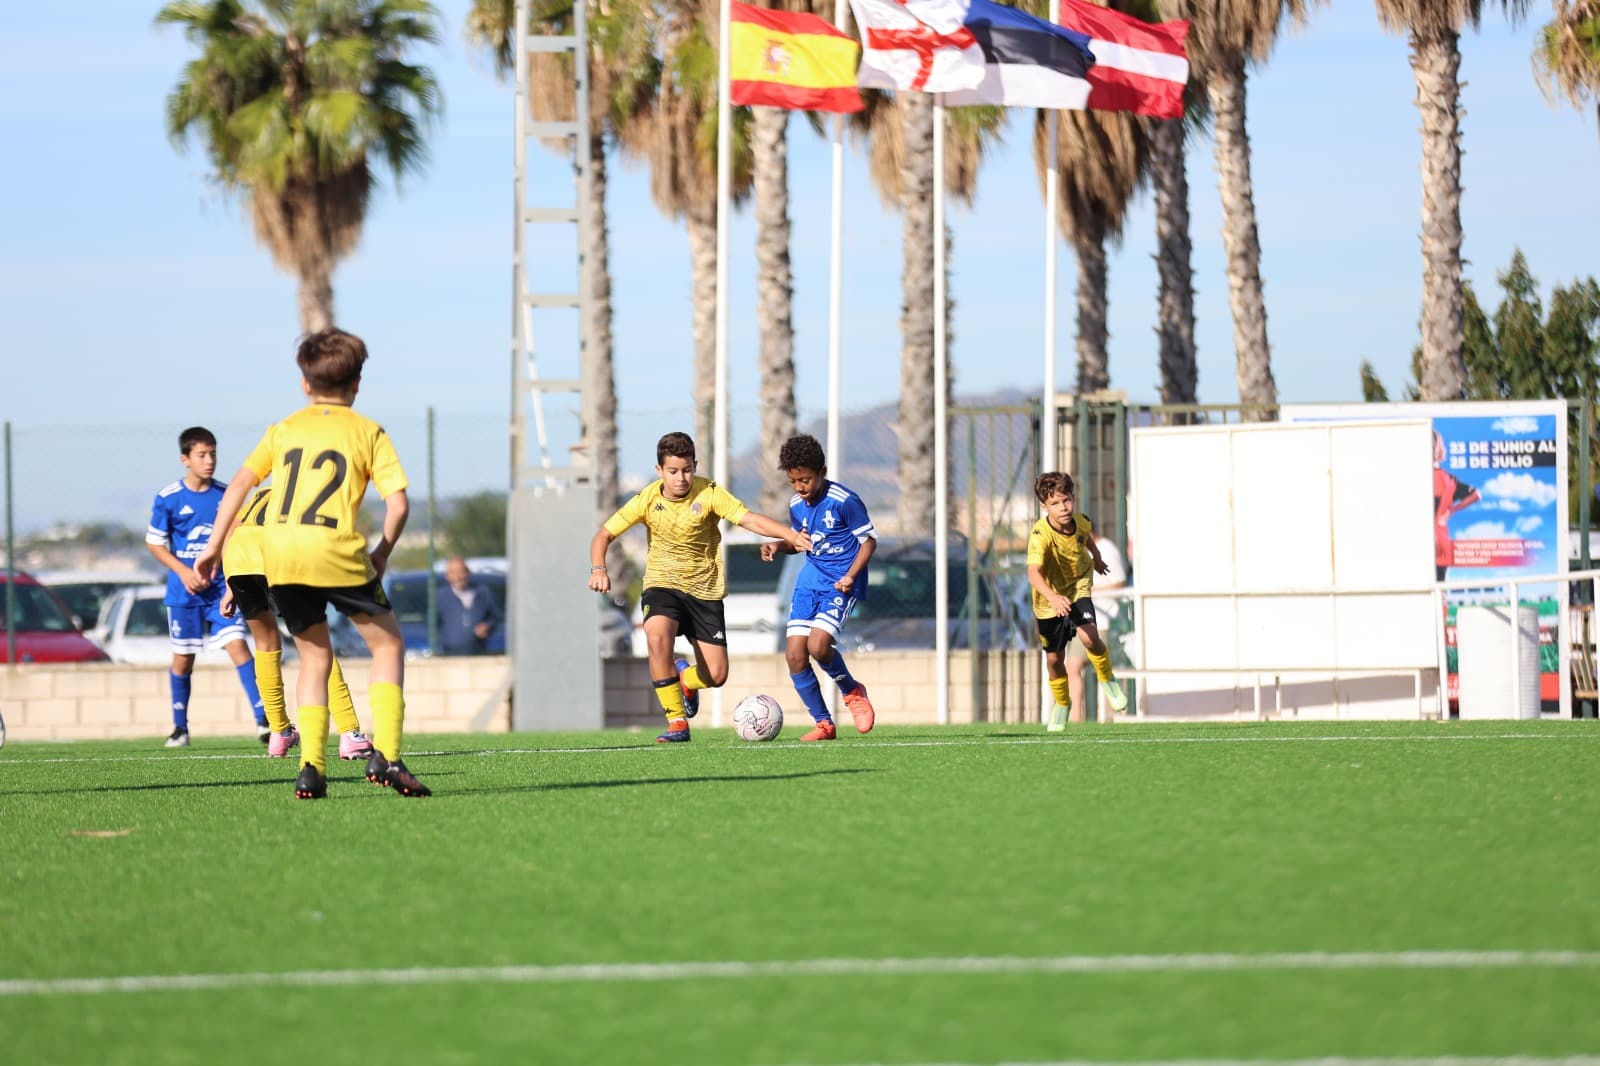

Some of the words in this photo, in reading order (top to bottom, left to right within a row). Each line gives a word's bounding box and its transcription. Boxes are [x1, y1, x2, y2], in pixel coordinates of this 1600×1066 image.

[1469, 440, 1490, 455] DE
[1491, 439, 1535, 454] JUNIO
[1537, 439, 1557, 453] AL
[1469, 455, 1490, 470] DE
[1491, 454, 1534, 469] JULIO
[278, 447, 348, 529] 12
